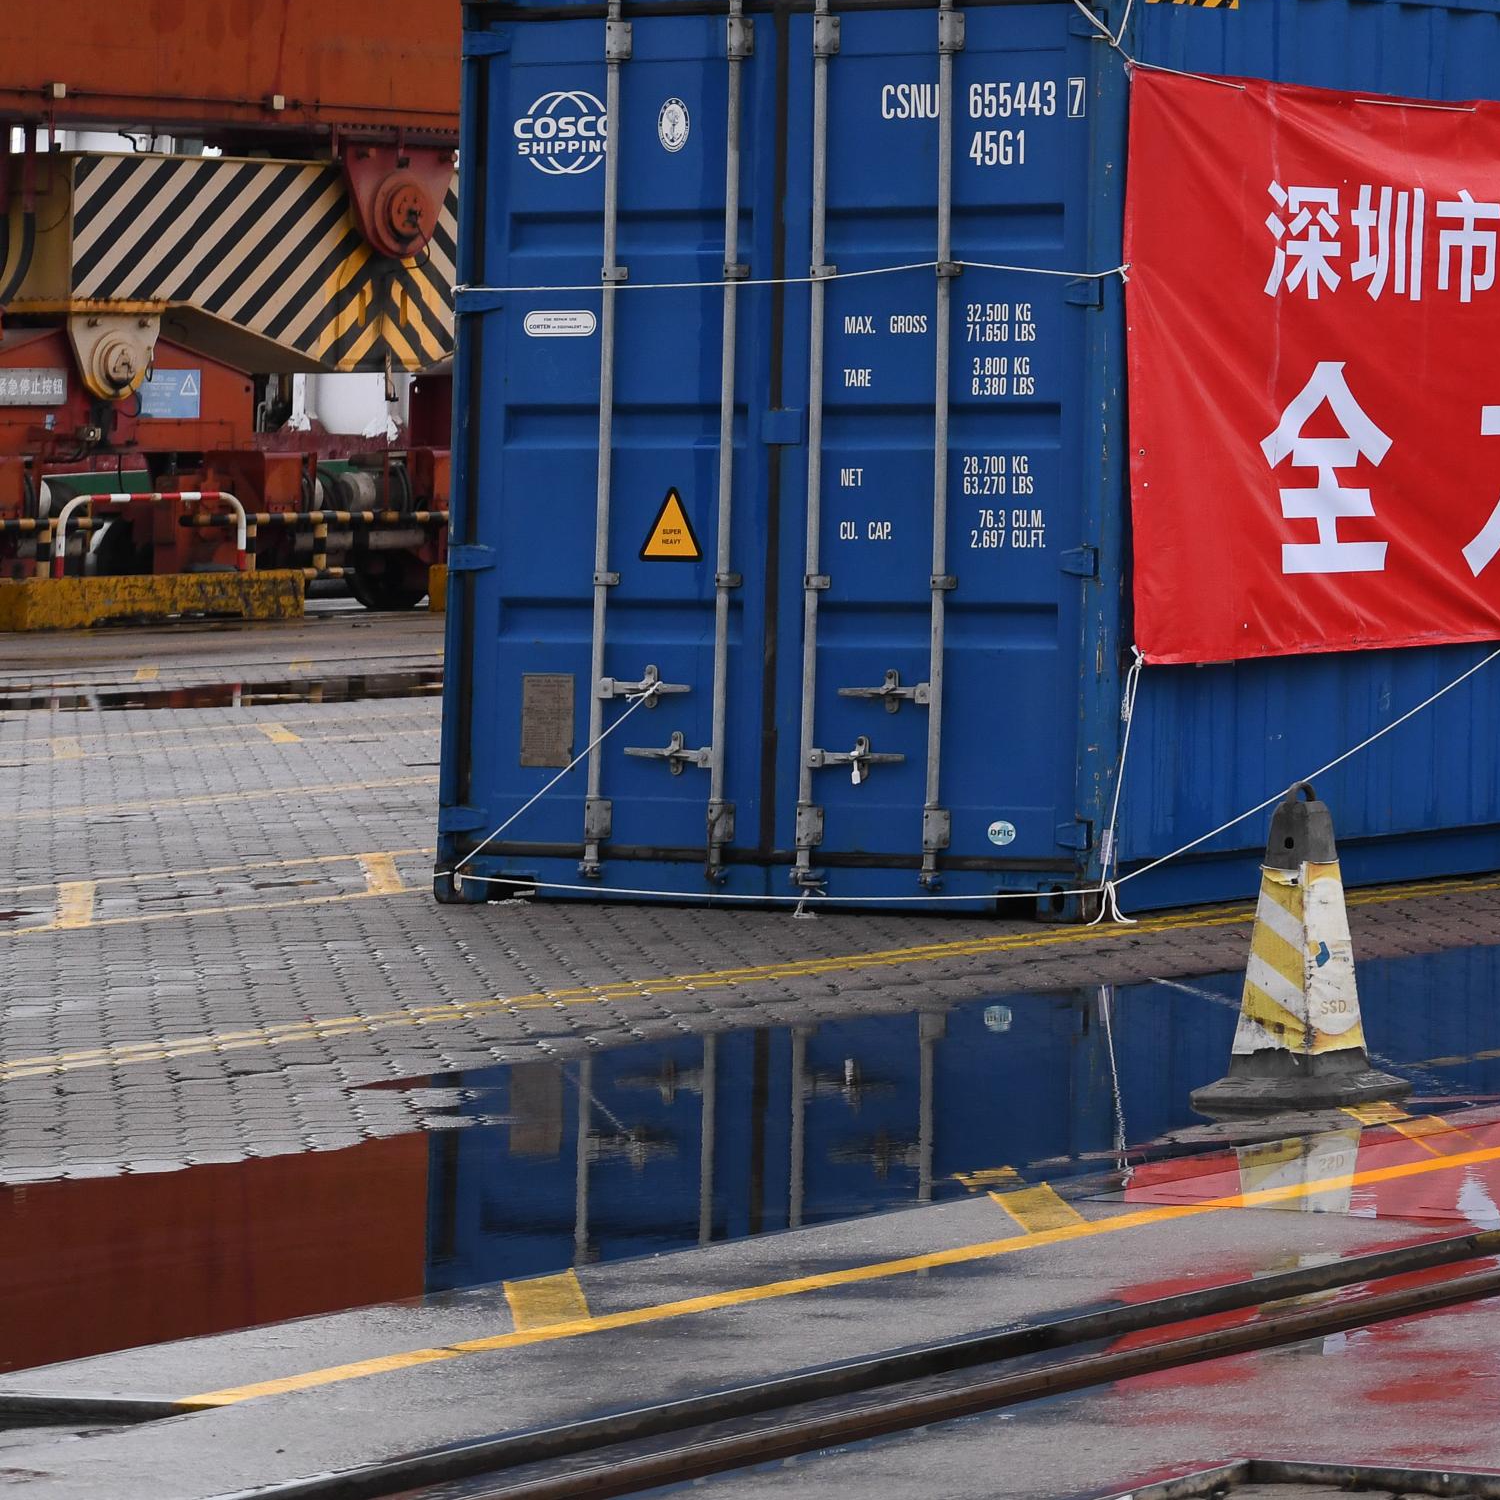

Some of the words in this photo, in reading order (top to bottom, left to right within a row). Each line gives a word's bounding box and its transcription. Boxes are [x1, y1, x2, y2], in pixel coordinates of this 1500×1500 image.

[881, 83, 940, 119] CSNU
[969, 81, 1056, 118] 655443
[1069, 78, 1084, 116] 7
[518, 140, 607, 155] SHIPPIN
[969, 129, 1025, 166] 45G1
[1015, 303, 1032, 322] KG
[844, 315, 876, 334] MAX.
[889, 315, 928, 334] GROSS
[1014, 323, 1036, 342] LBS
[1013, 356, 1030, 375] KG
[843, 368, 872, 387] TARE
[1012, 377, 1035, 396] LBS
[1012, 455, 1029, 474] KG
[840, 468, 864, 487] NET
[1012, 476, 1034, 495] LBS
[978, 509, 1006, 528] 76.3
[1012, 509, 1046, 528] CU.M.
[839, 521, 859, 540] CU.
[868, 521, 892, 540] CAP.
[1012, 530, 1046, 549] CU.FT.
[990, 828, 1014, 838] DFIC
[1320, 999, 1347, 1016] SSD
